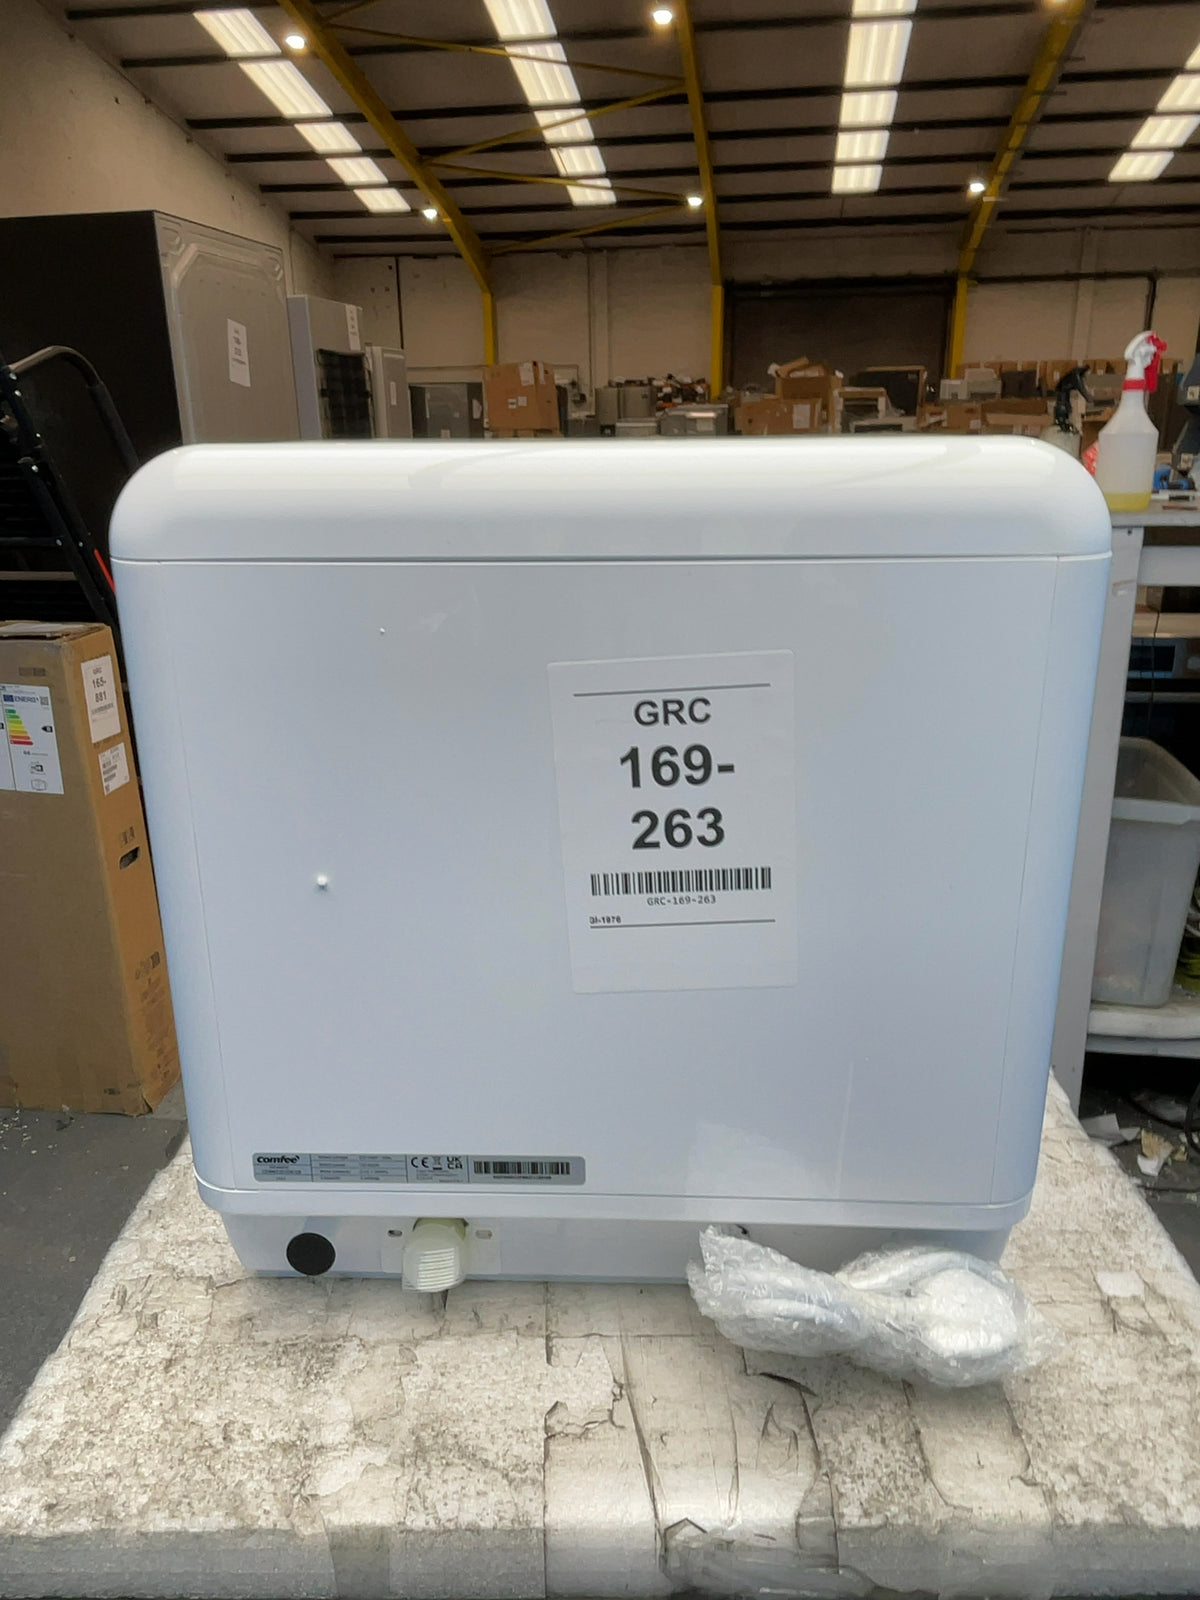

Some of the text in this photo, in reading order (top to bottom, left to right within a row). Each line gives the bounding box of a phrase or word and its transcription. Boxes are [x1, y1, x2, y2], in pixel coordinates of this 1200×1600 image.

[633, 697, 712, 727] GRC
[620, 744, 735, 788] 169-
[631, 807, 725, 850] 263
[646, 895, 717, 906] GRC-169-263
